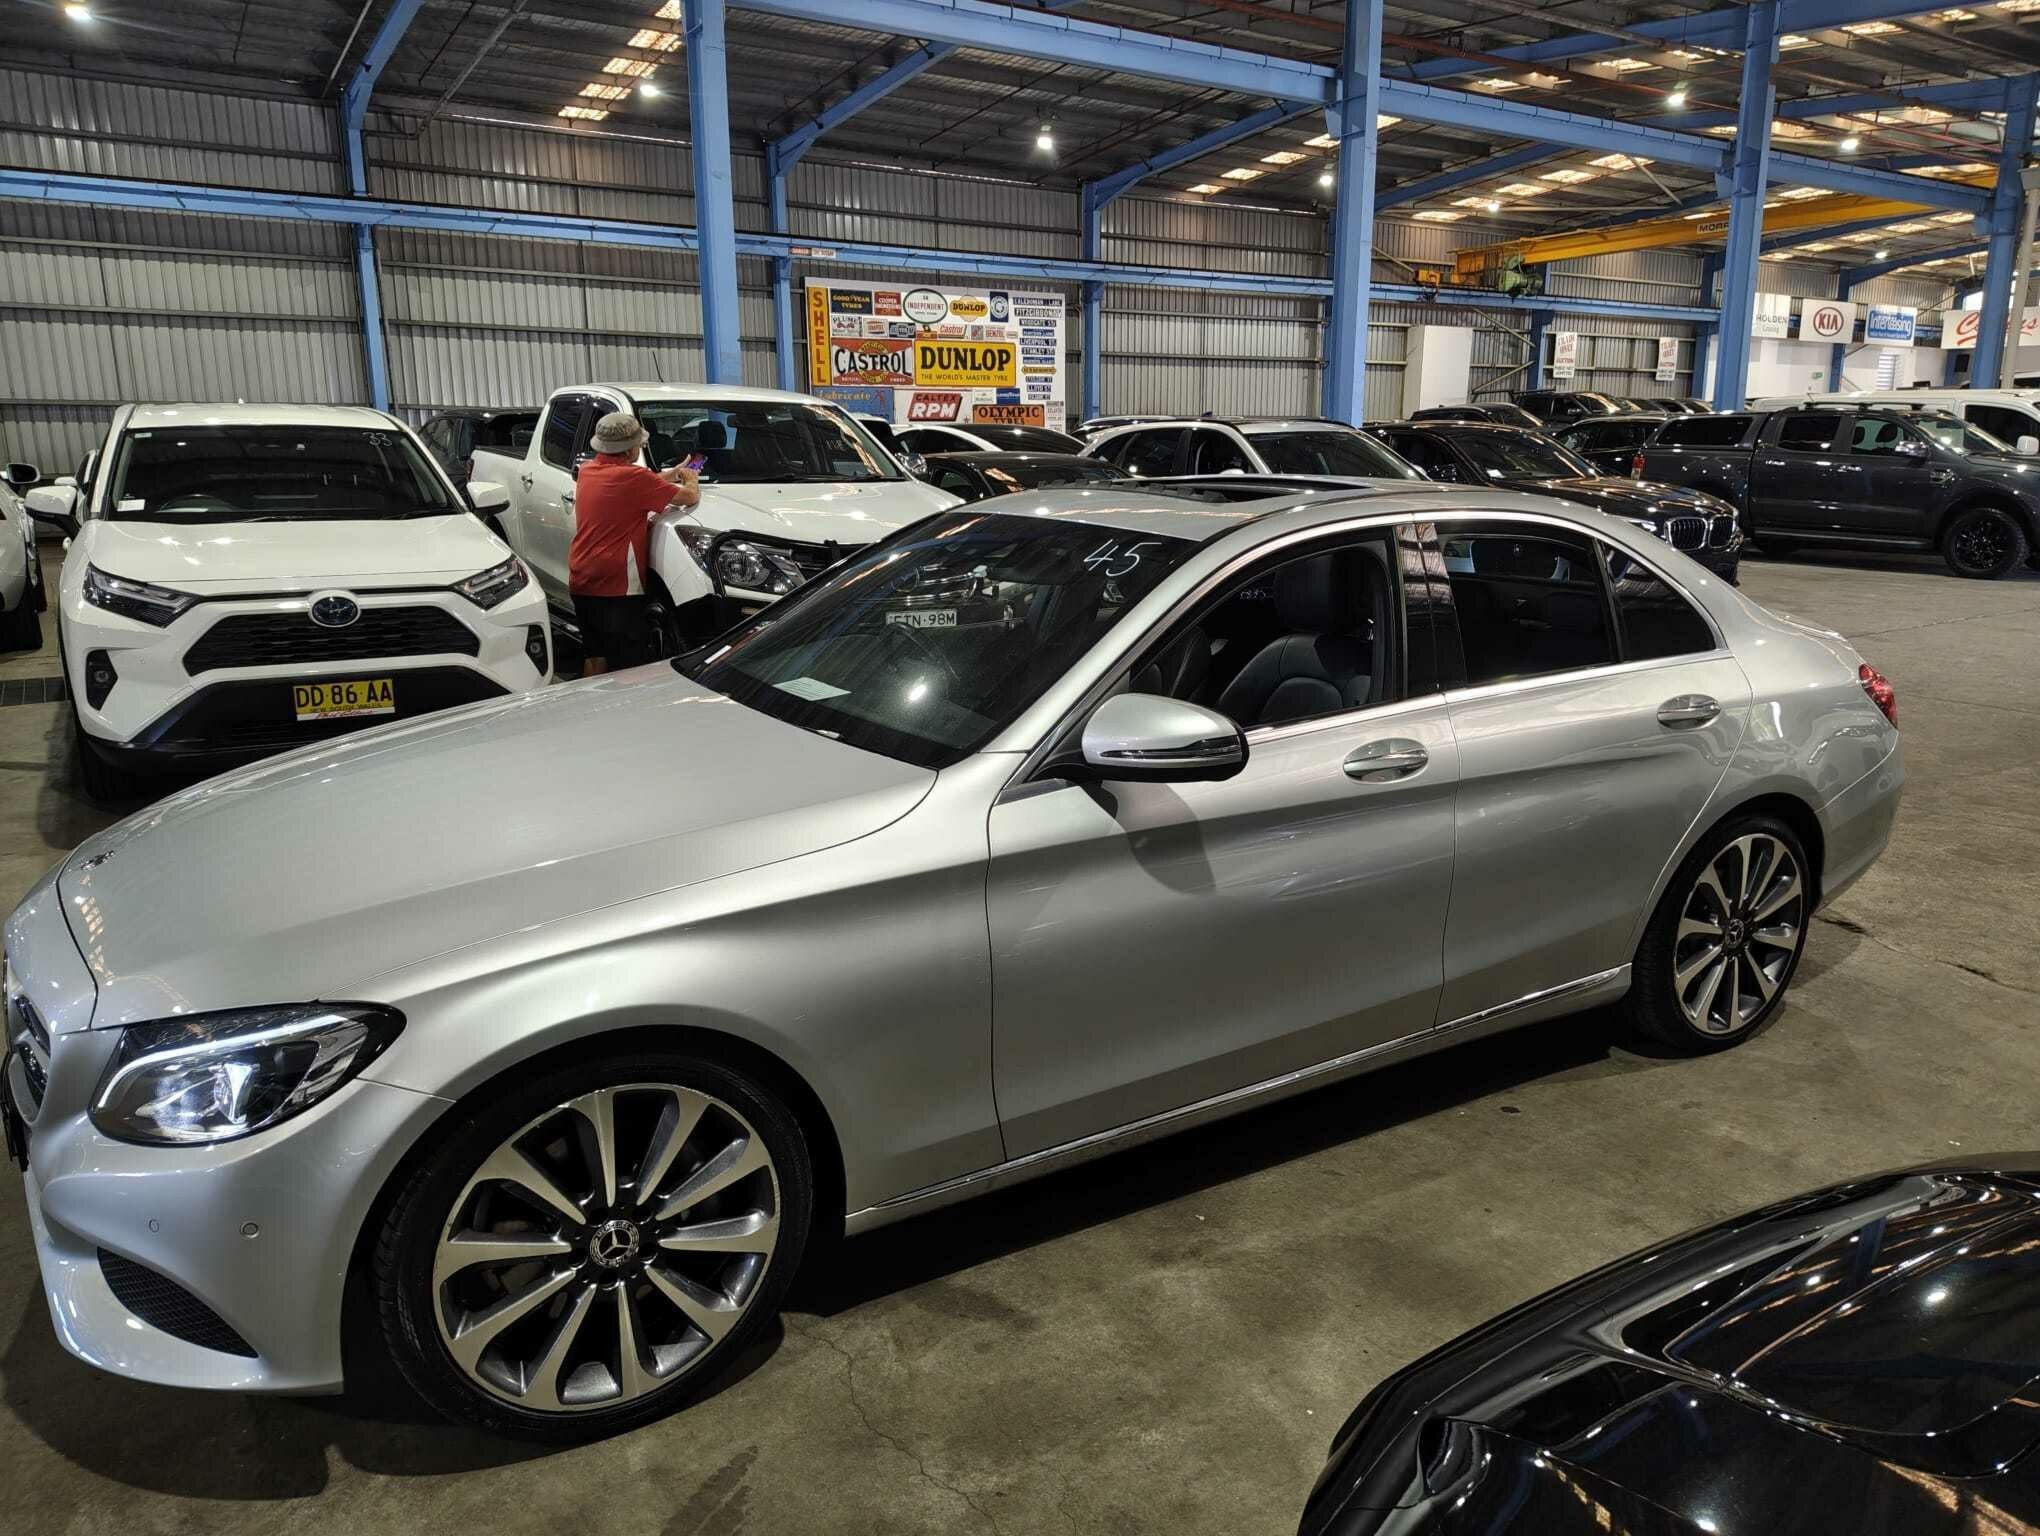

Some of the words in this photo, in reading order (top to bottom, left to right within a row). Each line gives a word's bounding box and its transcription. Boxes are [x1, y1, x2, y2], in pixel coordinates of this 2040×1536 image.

[907, 302, 945, 311] INDEPENDENT
[952, 302, 986, 312] DUNLOP
[1756, 313, 1787, 325] HOLDEN
[1818, 313, 1838, 331] KIA
[939, 325, 964, 334] Castrol
[812, 291, 826, 383] SHELL
[834, 348, 912, 376] CASTROL
[919, 346, 1011, 372] DUNLOP
[911, 402, 957, 418] RPM
[978, 406, 1040, 418] OLYMPIC
[993, 417, 1025, 425] TYRES
[1083, 539, 1163, 577] 45
